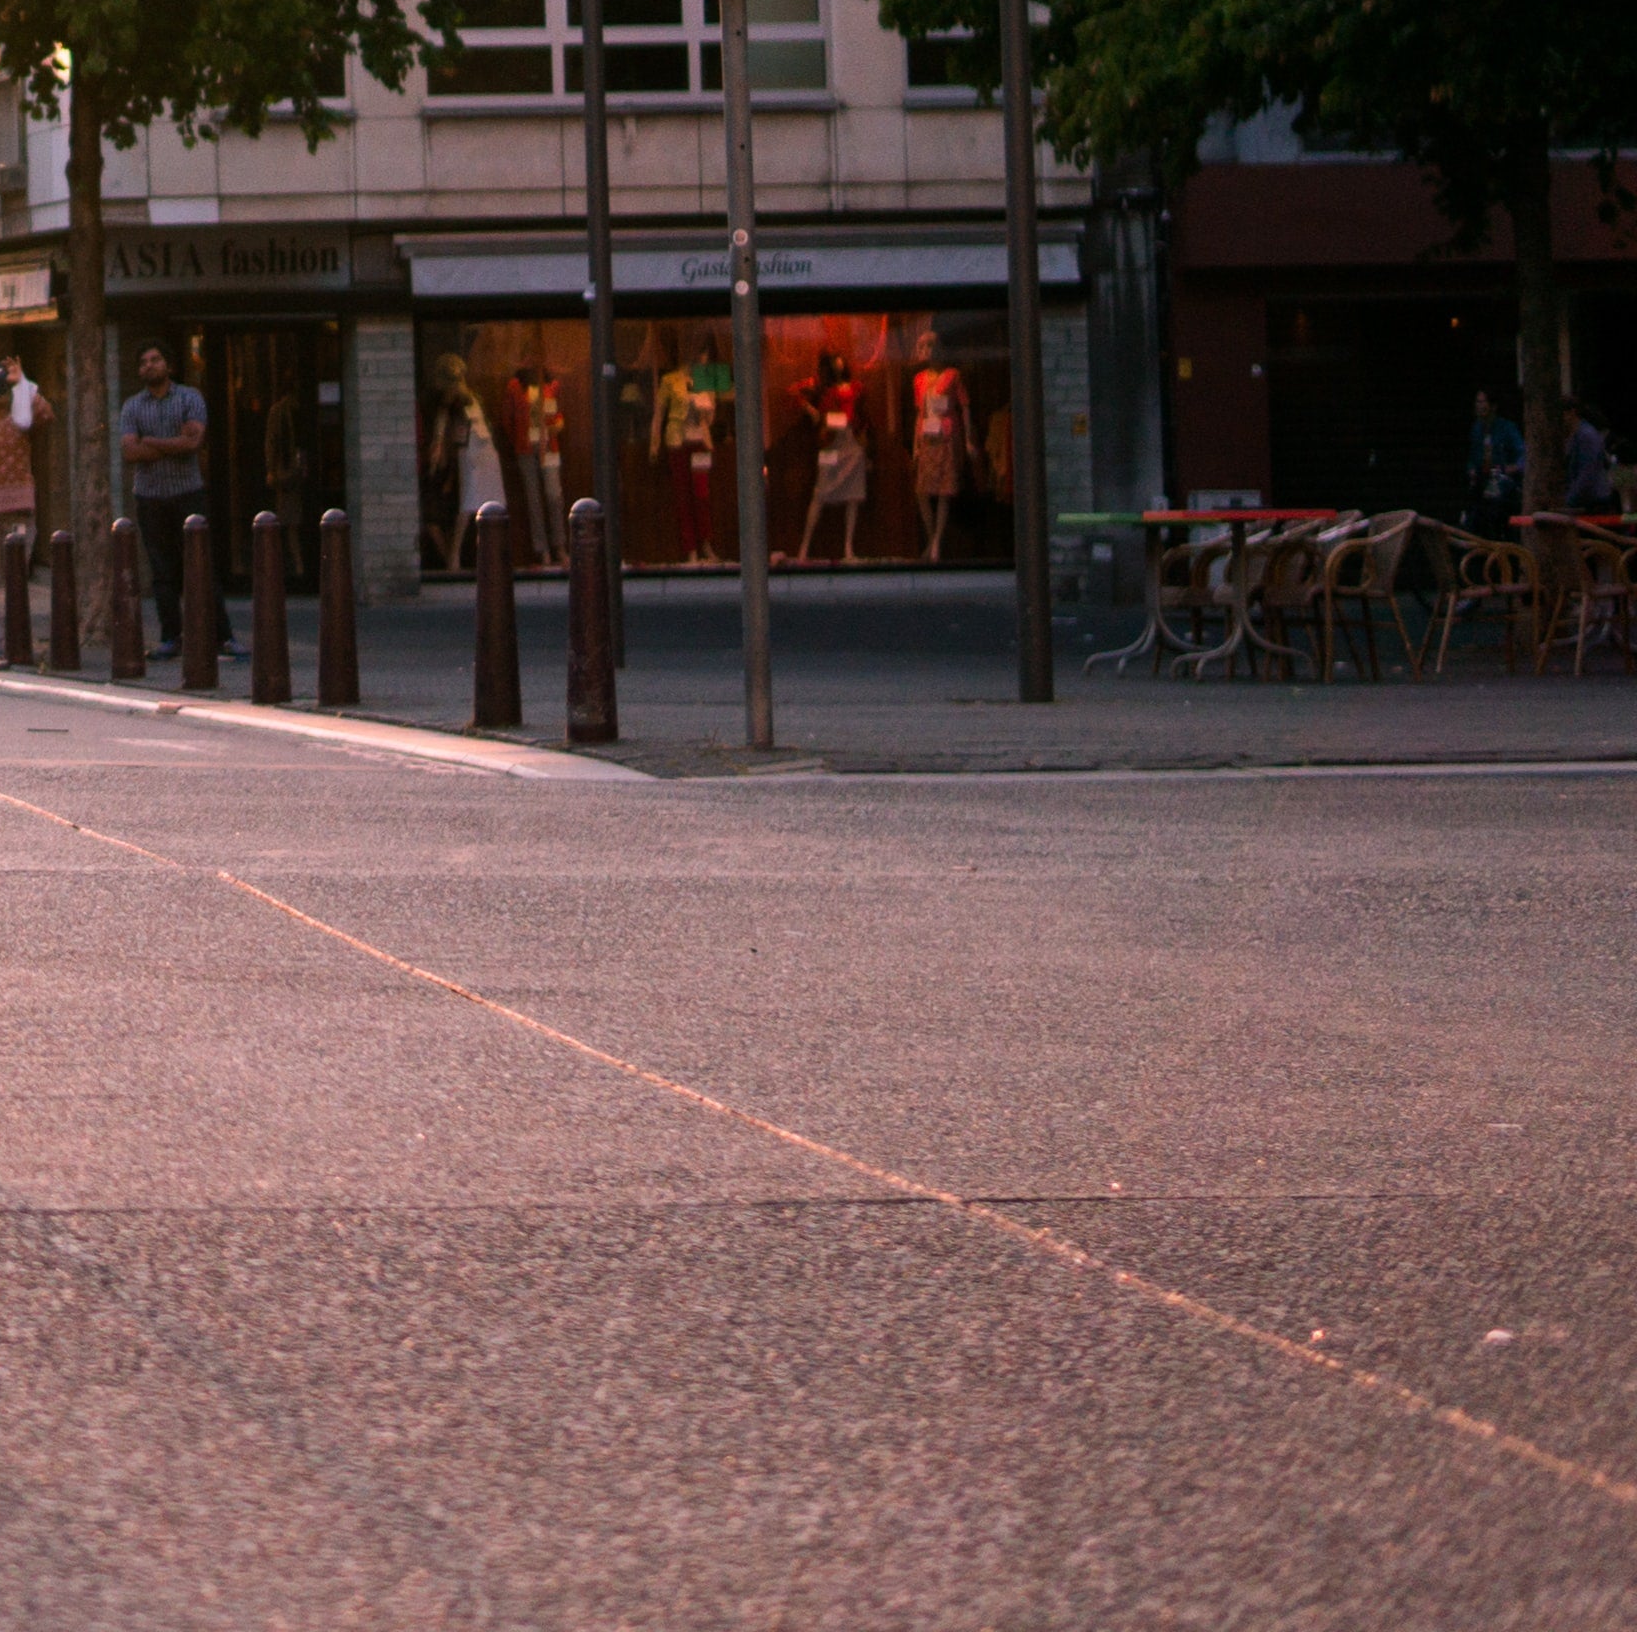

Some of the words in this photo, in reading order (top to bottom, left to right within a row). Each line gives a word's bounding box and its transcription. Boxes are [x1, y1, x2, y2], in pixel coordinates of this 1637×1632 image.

[109, 241, 205, 278] ASIA
[221, 237, 340, 276] fashion
[681, 255, 732, 284] Gasi
